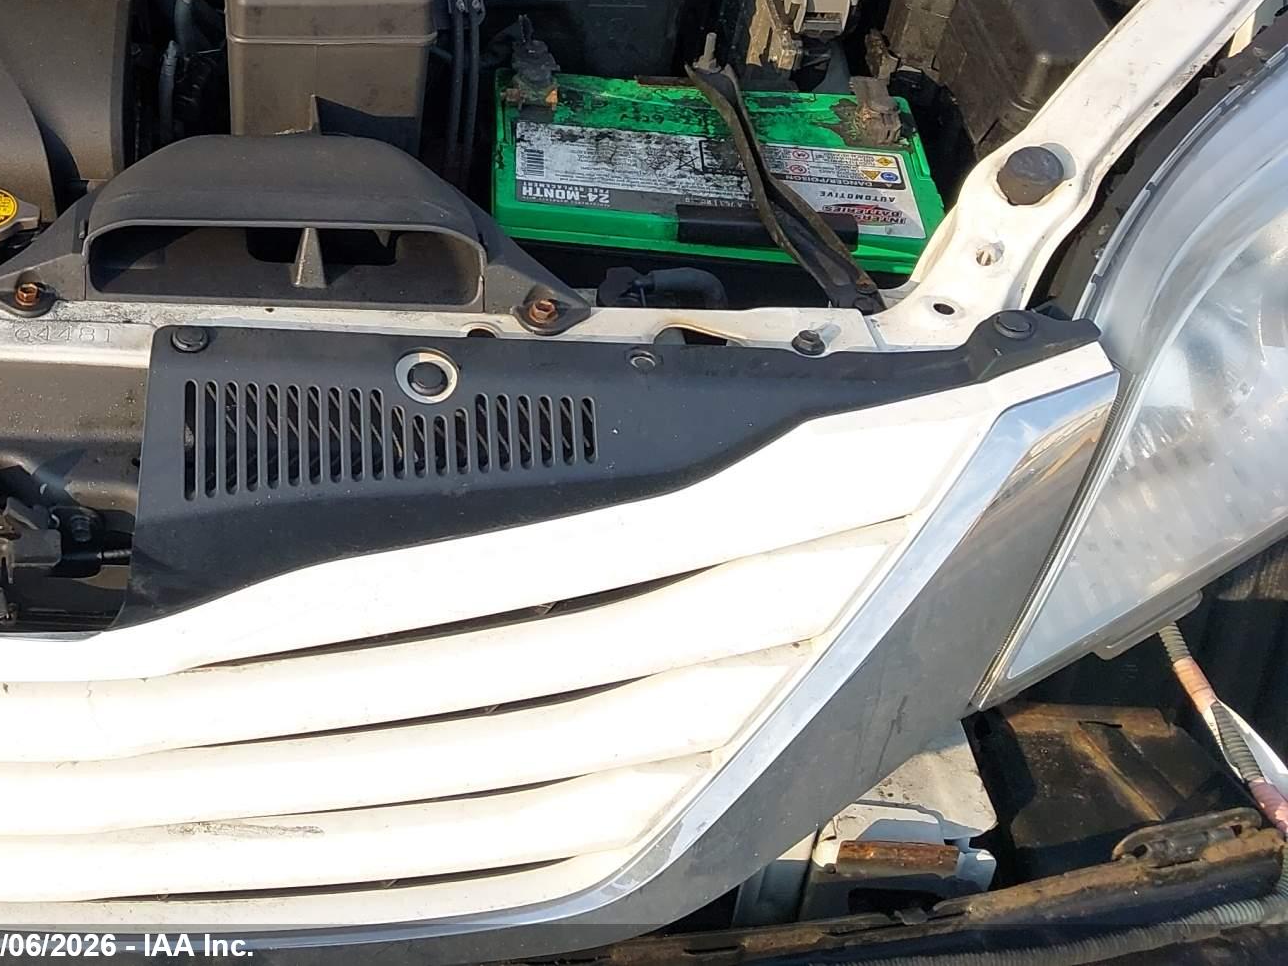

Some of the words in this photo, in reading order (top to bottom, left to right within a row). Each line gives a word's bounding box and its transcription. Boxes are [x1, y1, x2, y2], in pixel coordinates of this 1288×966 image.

[785, 174, 874, 187] DANGER/POISON
[522, 185, 610, 203] 24-MONTH
[819, 190, 896, 202] AUTOMOTIVE
[822, 203, 902, 217] BATTERIES
